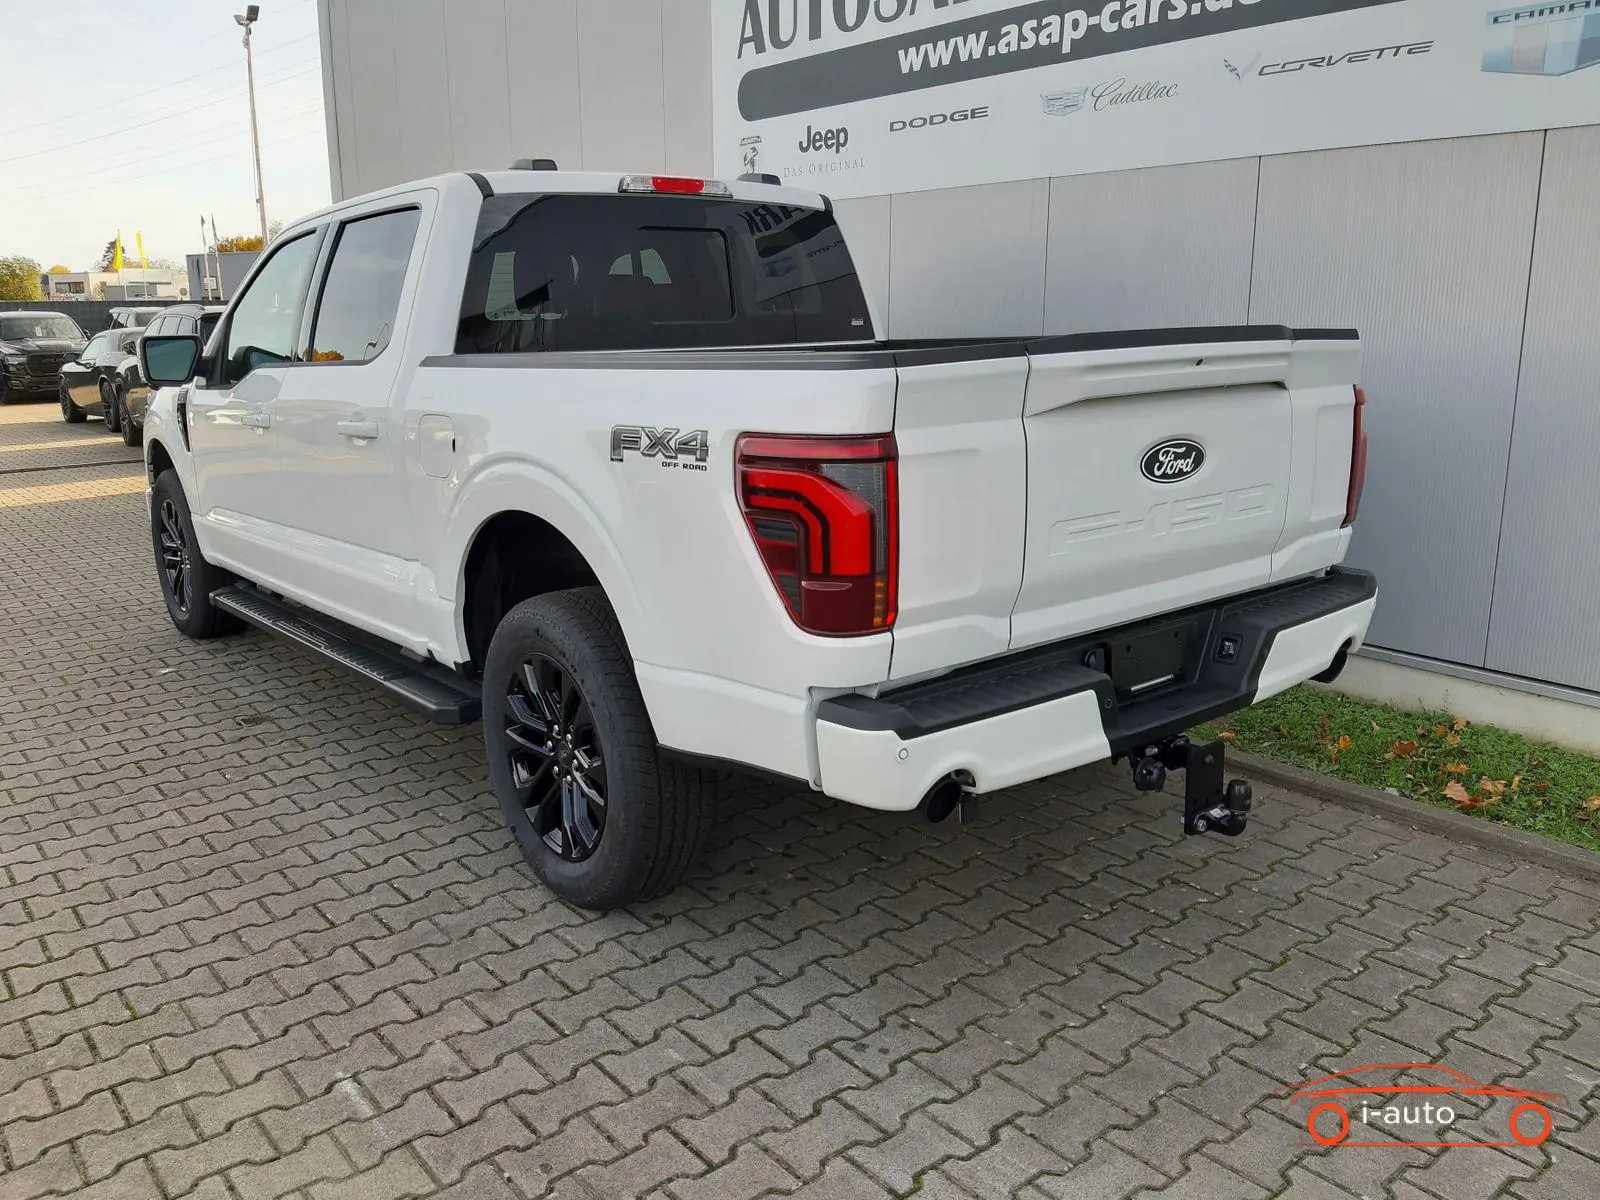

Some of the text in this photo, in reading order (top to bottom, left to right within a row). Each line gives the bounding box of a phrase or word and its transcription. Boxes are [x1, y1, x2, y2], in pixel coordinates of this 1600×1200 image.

[1258, 40, 1434, 77] CORVETTE
[1091, 77, 1178, 112] Cadillac
[889, 106, 989, 132] DODGE
[798, 124, 849, 154] Jeep
[609, 424, 709, 462] FX4
[661, 461, 707, 472] OFF ROAD
[1153, 446, 1197, 476] Ford
